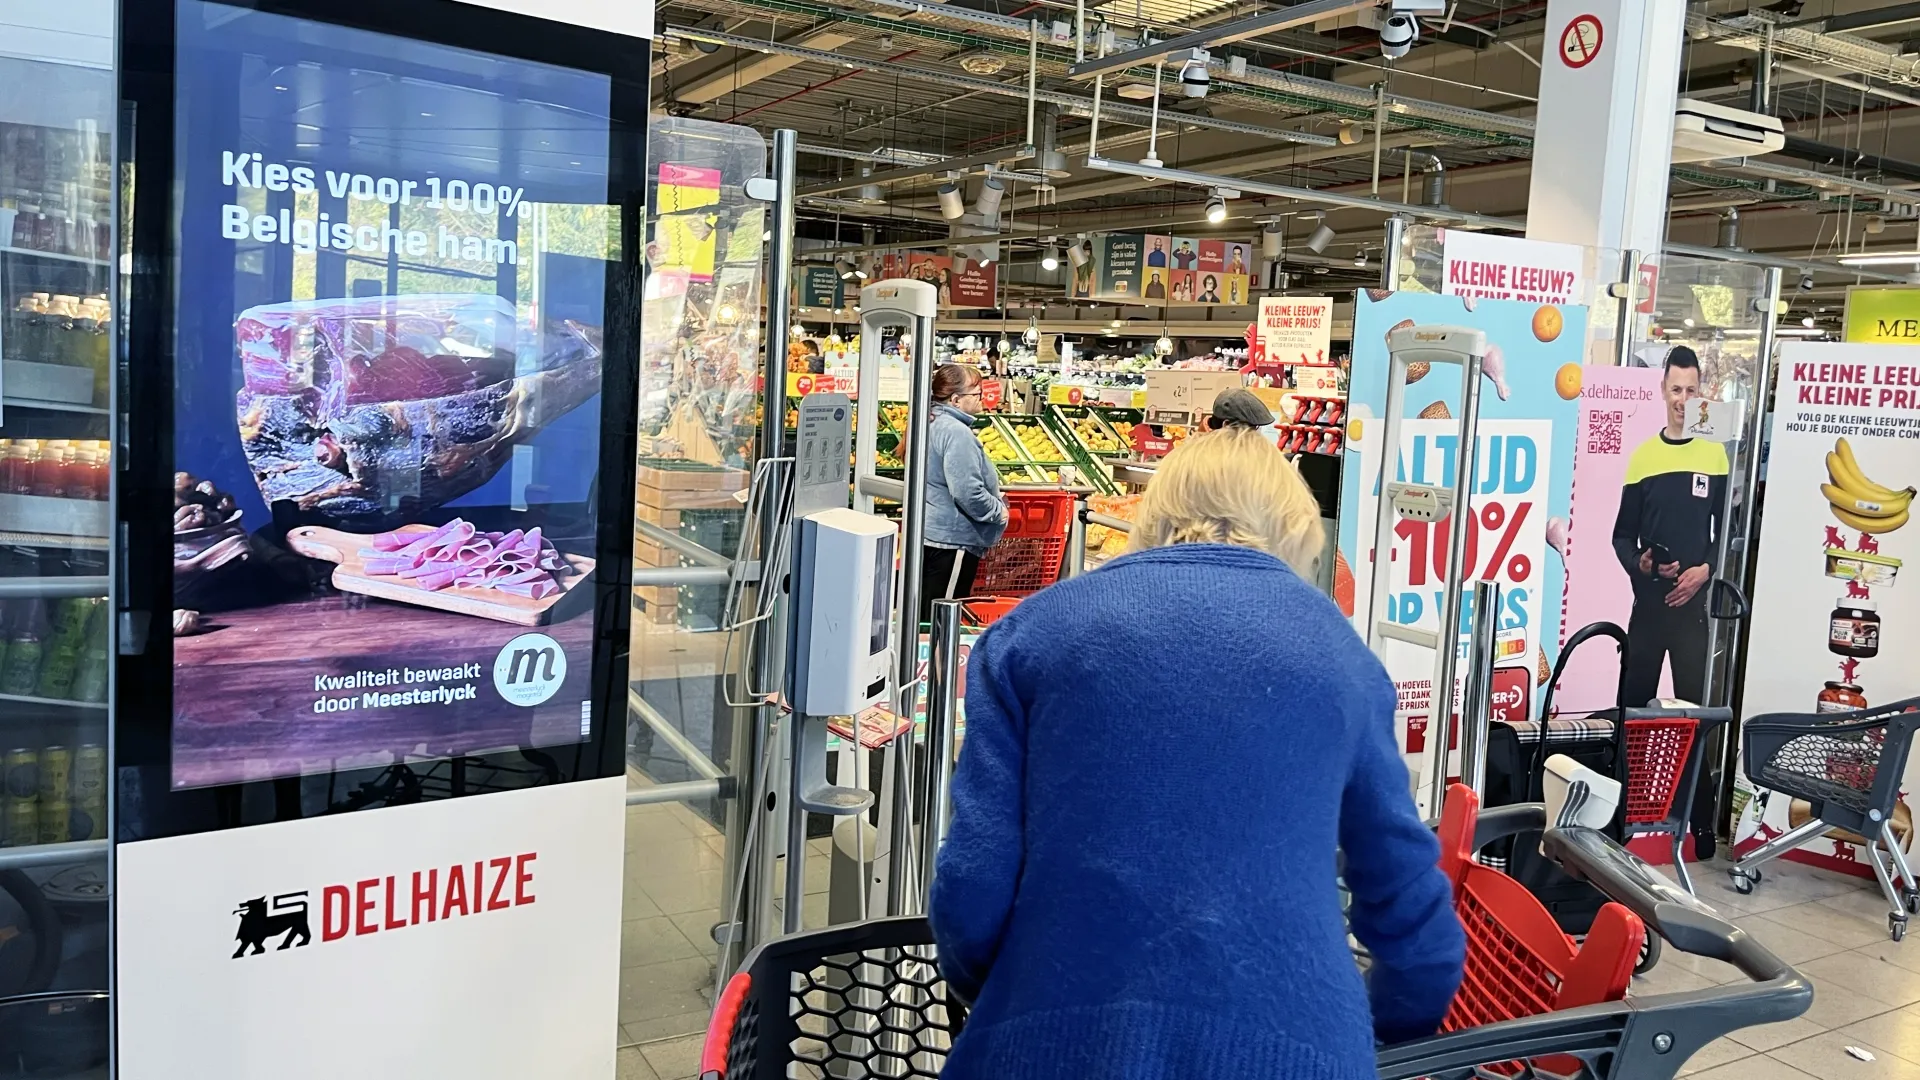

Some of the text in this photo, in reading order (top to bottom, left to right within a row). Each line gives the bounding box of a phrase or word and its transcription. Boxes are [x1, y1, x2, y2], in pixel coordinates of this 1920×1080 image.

[222, 150, 532, 219] Kies voor 100%
[222, 203, 428, 255] Belgische
[1450, 259, 1575, 295] KLEINE LEEUW?
[1264, 305, 1326, 317] KLEINE LEEUW?
[1266, 317, 1321, 329] KLEINE PRIJS!
[1876, 319, 1920, 338] ME
[1793, 362, 1867, 384] KLEINE
[1579, 384, 1653, 401] s.delhaize.be
[1798, 385, 1920, 410] KLEINE PRI
[1797, 412, 1821, 422] VOLG
[1824, 413, 1836, 424] DE
[1839, 415, 1872, 426] KLEINE
[1786, 422, 1807, 432] HOU
[1809, 424, 1819, 433] JE
[1821, 424, 1860, 436] BUDGET
[1862, 427, 1896, 438] ONDER
[314, 662, 482, 692] Kwaliteit bewaakt
[1402, 680, 1432, 690] HOEVEEL
[313, 683, 477, 713] door Meesterlyck
[1397, 690, 1431, 700] ALT DANK
[1405, 700, 1430, 710] PRIJSK
[321, 851, 538, 942] DELHAIZE
